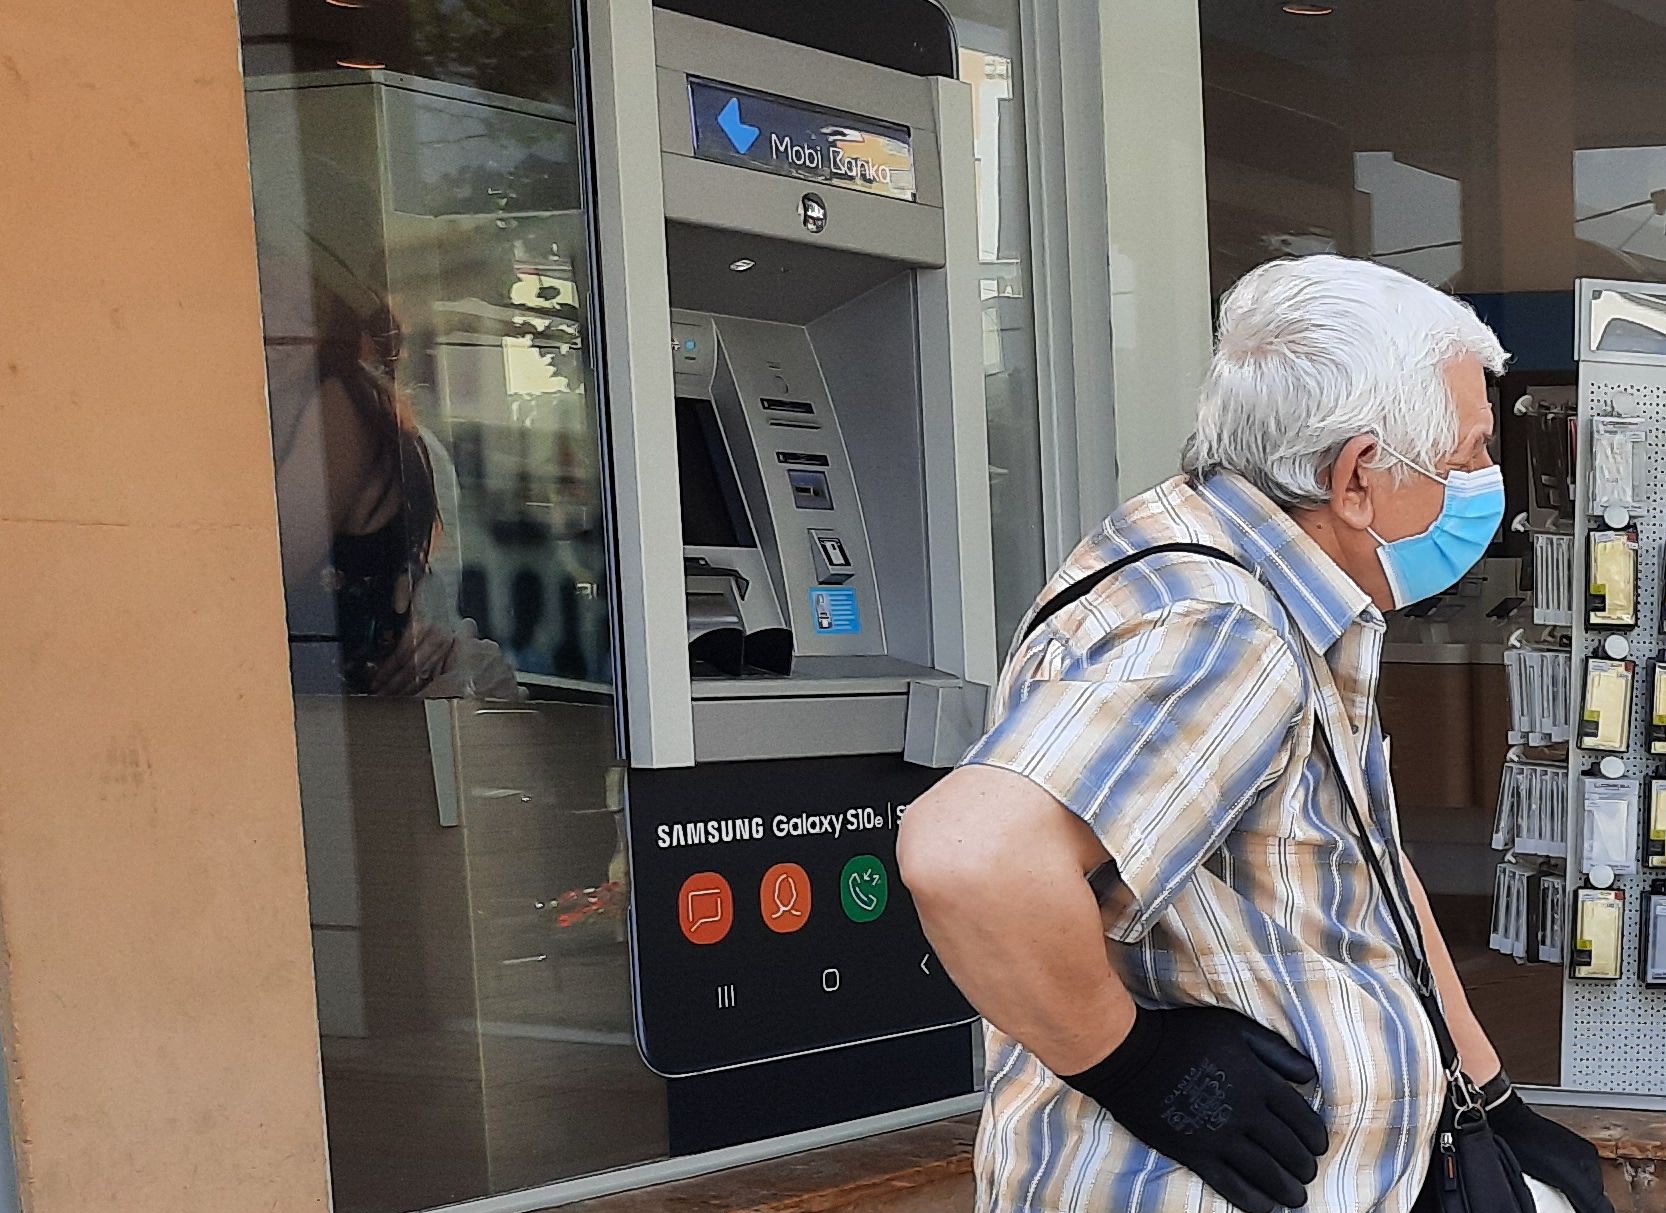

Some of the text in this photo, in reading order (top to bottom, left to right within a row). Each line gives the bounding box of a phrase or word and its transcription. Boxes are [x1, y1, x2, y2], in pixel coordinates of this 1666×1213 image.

[771, 133, 891, 183] Mobi Banka
[657, 817, 763, 848] SAMSUNG
[772, 813, 843, 839] Galaxy
[846, 807, 883, 831] S10e
